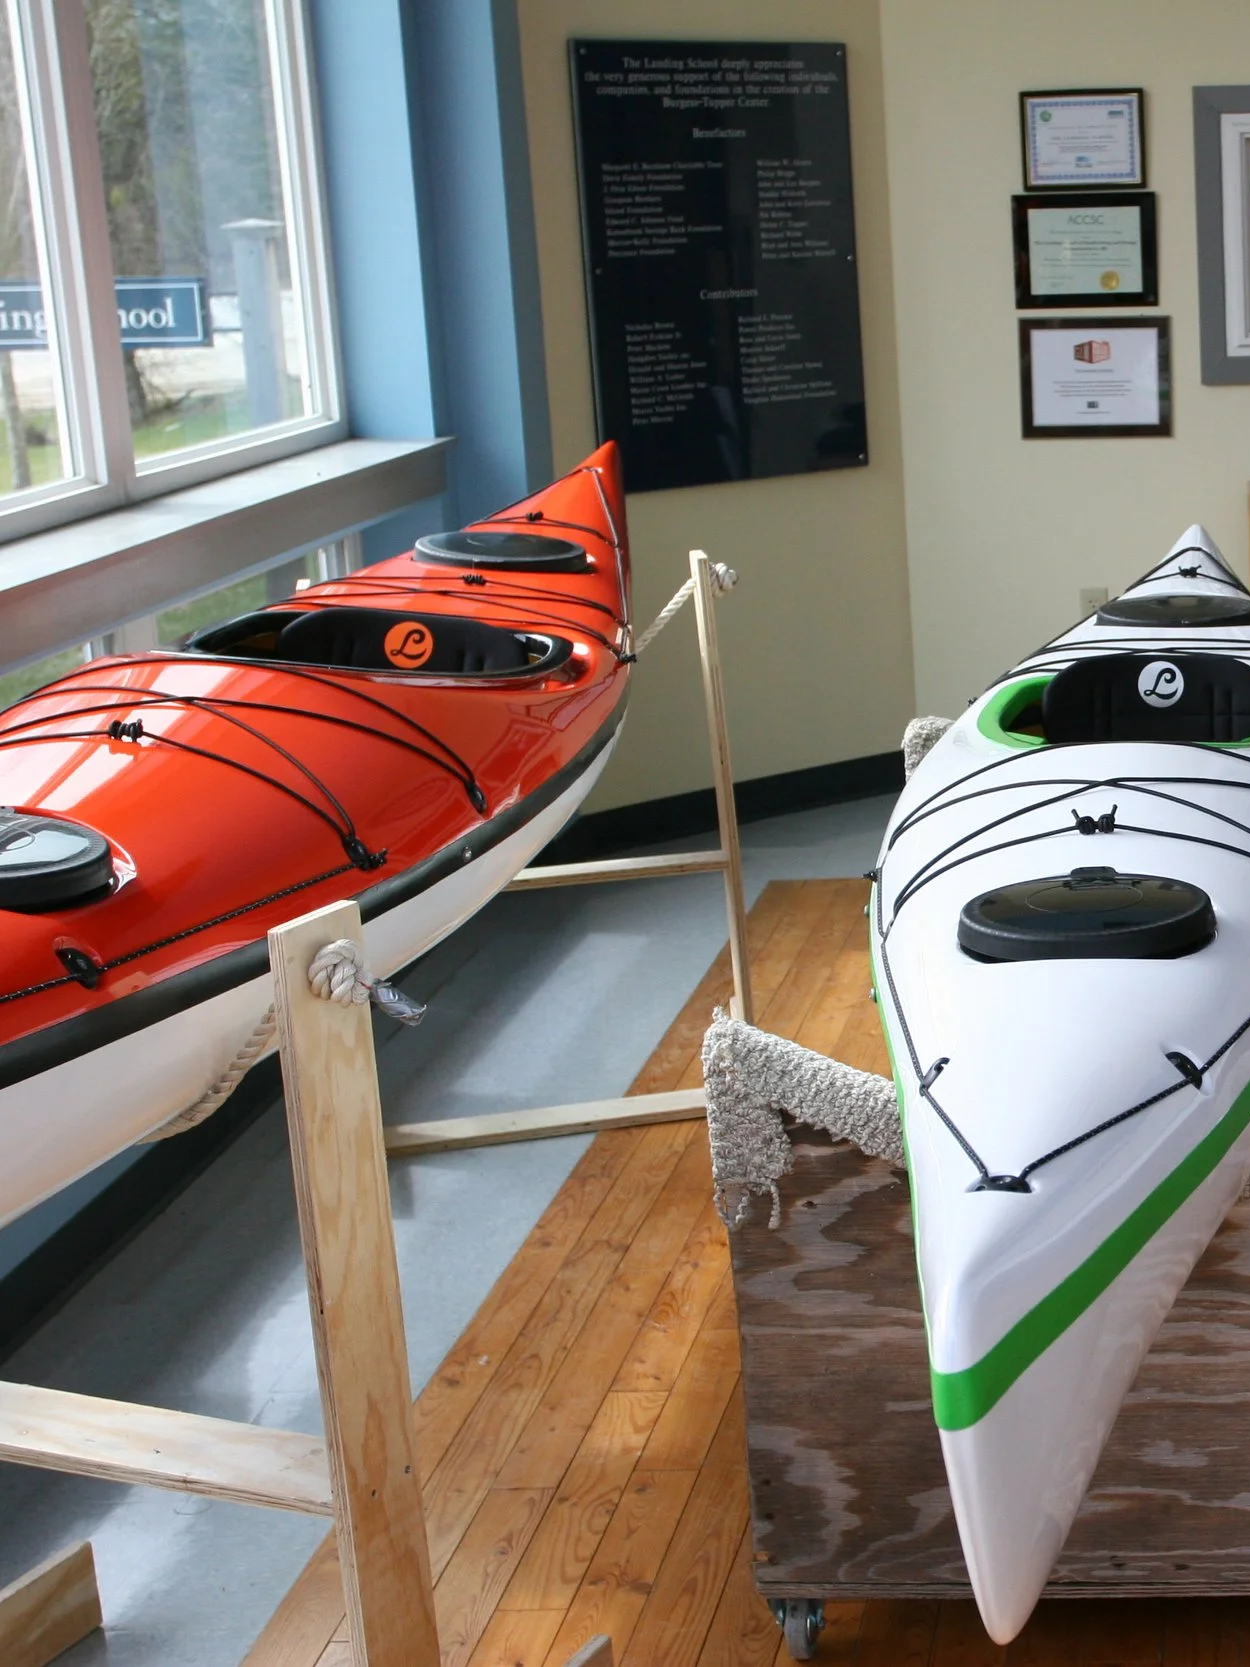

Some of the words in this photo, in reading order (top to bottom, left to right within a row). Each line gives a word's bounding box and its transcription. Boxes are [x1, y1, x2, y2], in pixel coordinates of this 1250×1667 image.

[622, 58, 641, 68] The
[644, 58, 683, 70] Landing
[687, 58, 717, 68] School
[692, 128, 746, 138] Benefactors
[1066, 214, 1104, 225] ACCSC
[700, 288, 758, 299] Contributors
